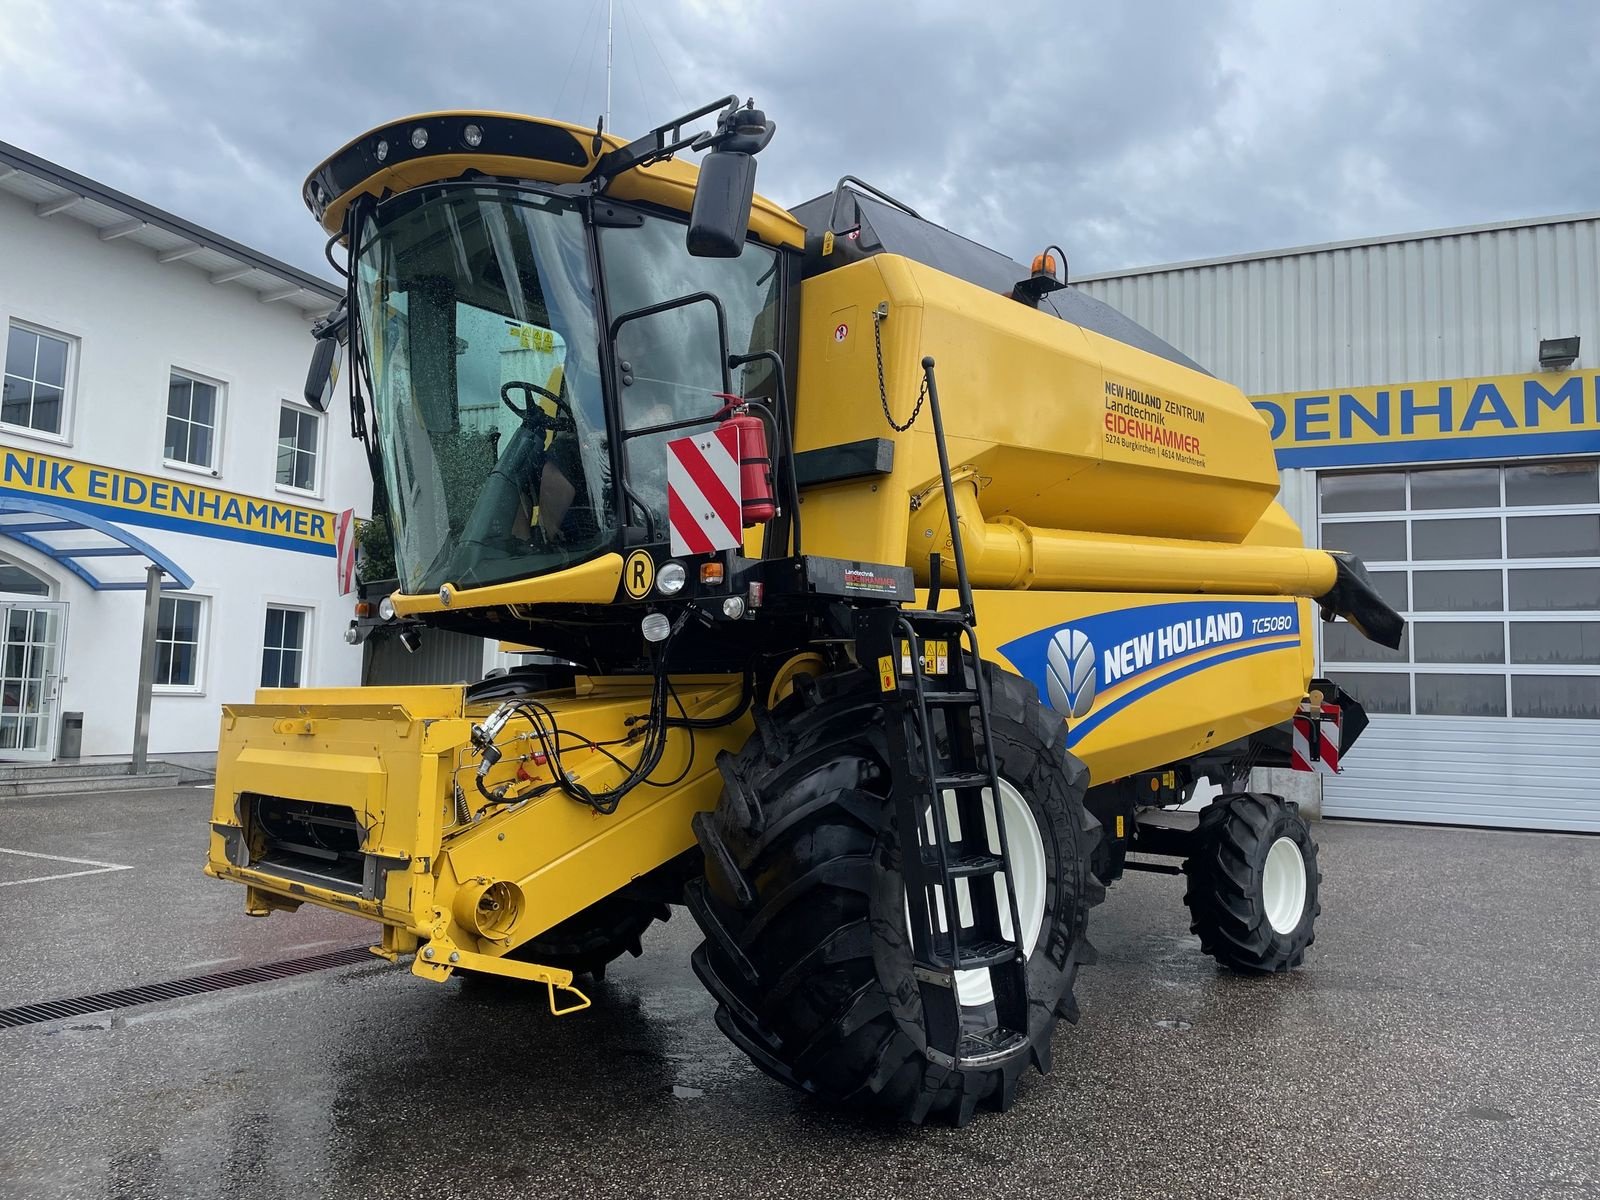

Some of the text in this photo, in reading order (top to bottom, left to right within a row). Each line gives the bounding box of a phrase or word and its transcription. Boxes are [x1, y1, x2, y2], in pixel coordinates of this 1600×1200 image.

[1105, 381, 1205, 424] NEW HOLLAND ZENTRUM
[1105, 396, 1165, 426] Landtechnik
[1251, 376, 1600, 442] DENHAM
[1105, 412, 1200, 456] EIDENHAMMER
[1105, 433, 1121, 446] 5274
[1121, 437, 1156, 455] Burgkirchen
[1161, 448, 1175, 460] 4614
[4, 452, 326, 539] NIK EIDENHAMMER
[633, 560, 646, 589] R
[1104, 611, 1292, 685] NEW HOLLAND TC5080
